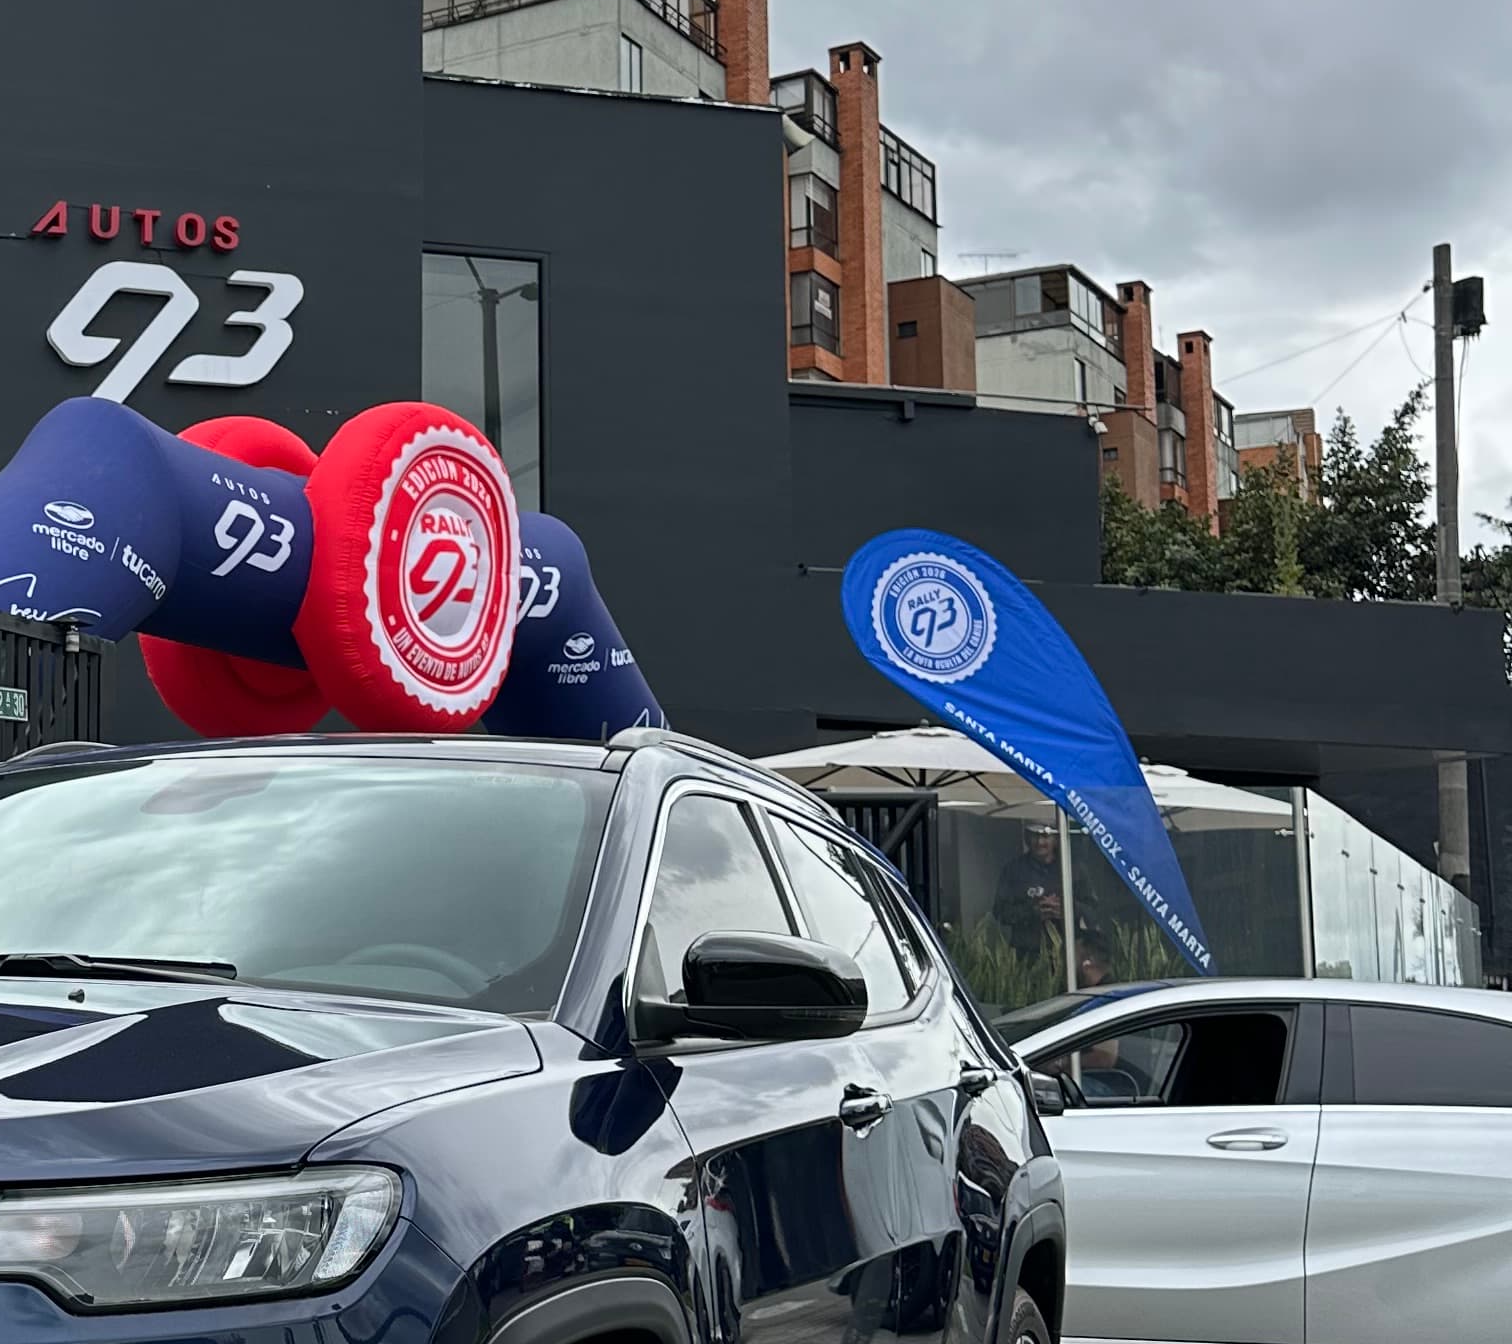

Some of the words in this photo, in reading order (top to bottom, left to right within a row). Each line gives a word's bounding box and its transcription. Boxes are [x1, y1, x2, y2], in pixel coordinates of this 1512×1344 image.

[31, 200, 241, 254] AUTOS
[46, 260, 304, 404] 93
[211, 473, 270, 504] AUTOS
[401, 456, 458, 501] EDICIÓN
[32, 523, 105, 554] mercado
[51, 537, 90, 560] libre
[210, 499, 295, 576] 93
[121, 544, 167, 600] tucarro
[907, 588, 941, 610] RALLY
[910, 596, 957, 648] 93
[392, 627, 414, 653] UN
[407, 643, 444, 679] EVENTO
[443, 662, 458, 681] DE
[548, 660, 600, 673] mercado
[557, 673, 588, 684] libre
[944, 701, 996, 742] SANTA
[1000, 740, 1053, 784] MARTA
[1068, 790, 1122, 859] MOMPOX
[1128, 866, 1169, 919] SANTA
[1168, 914, 1212, 968] MARTA
